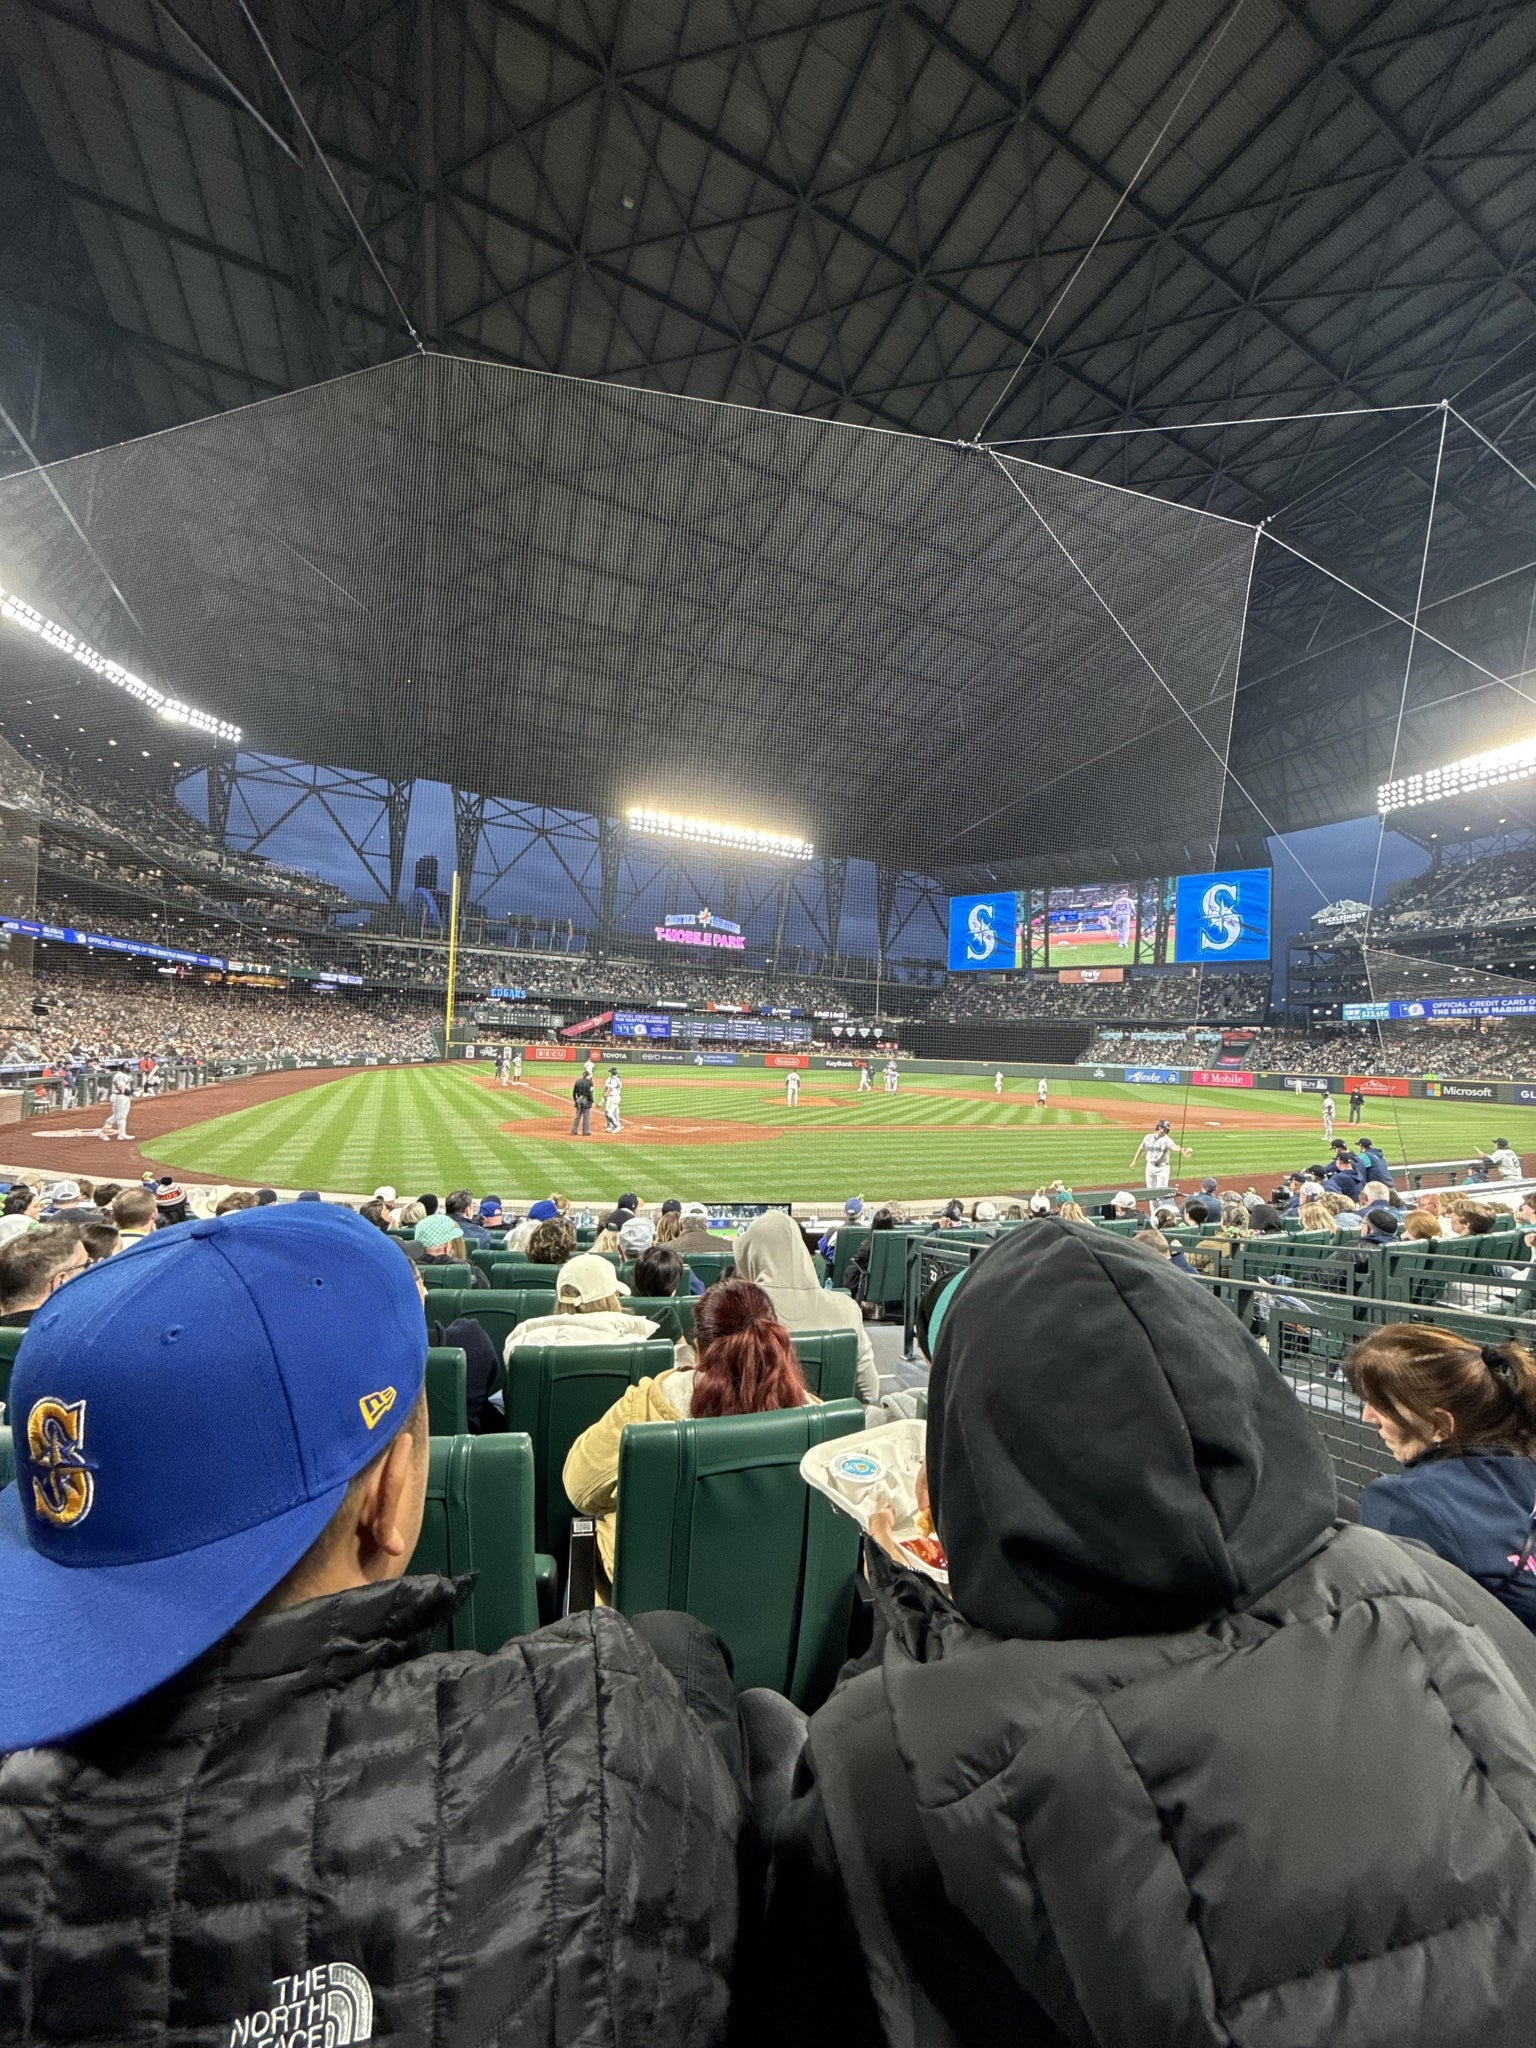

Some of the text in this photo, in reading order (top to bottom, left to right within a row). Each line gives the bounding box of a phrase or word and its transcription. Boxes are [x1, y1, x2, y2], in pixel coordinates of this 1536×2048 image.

[655, 926, 746, 950] T-MOBILE PARK
[1432, 1001, 1467, 1009] OFFICIAL
[1469, 1000, 1499, 1008] CREDIT
[1501, 999, 1526, 1007] CARD
[1451, 1007, 1489, 1015] SEATTLE
[1492, 1005, 1536, 1013] MARINER
[602, 1052, 627, 1060] TOYOTA
[642, 1053, 660, 1061] eero
[1127, 1071, 1161, 1083] Alaska
[1211, 1073, 1243, 1084] Mobile
[1443, 1086, 1492, 1097] Microsoft
[1520, 1090, 1536, 1099] GL
[273, 1964, 327, 2005] THE
[229, 1993, 327, 2048] NORTH
